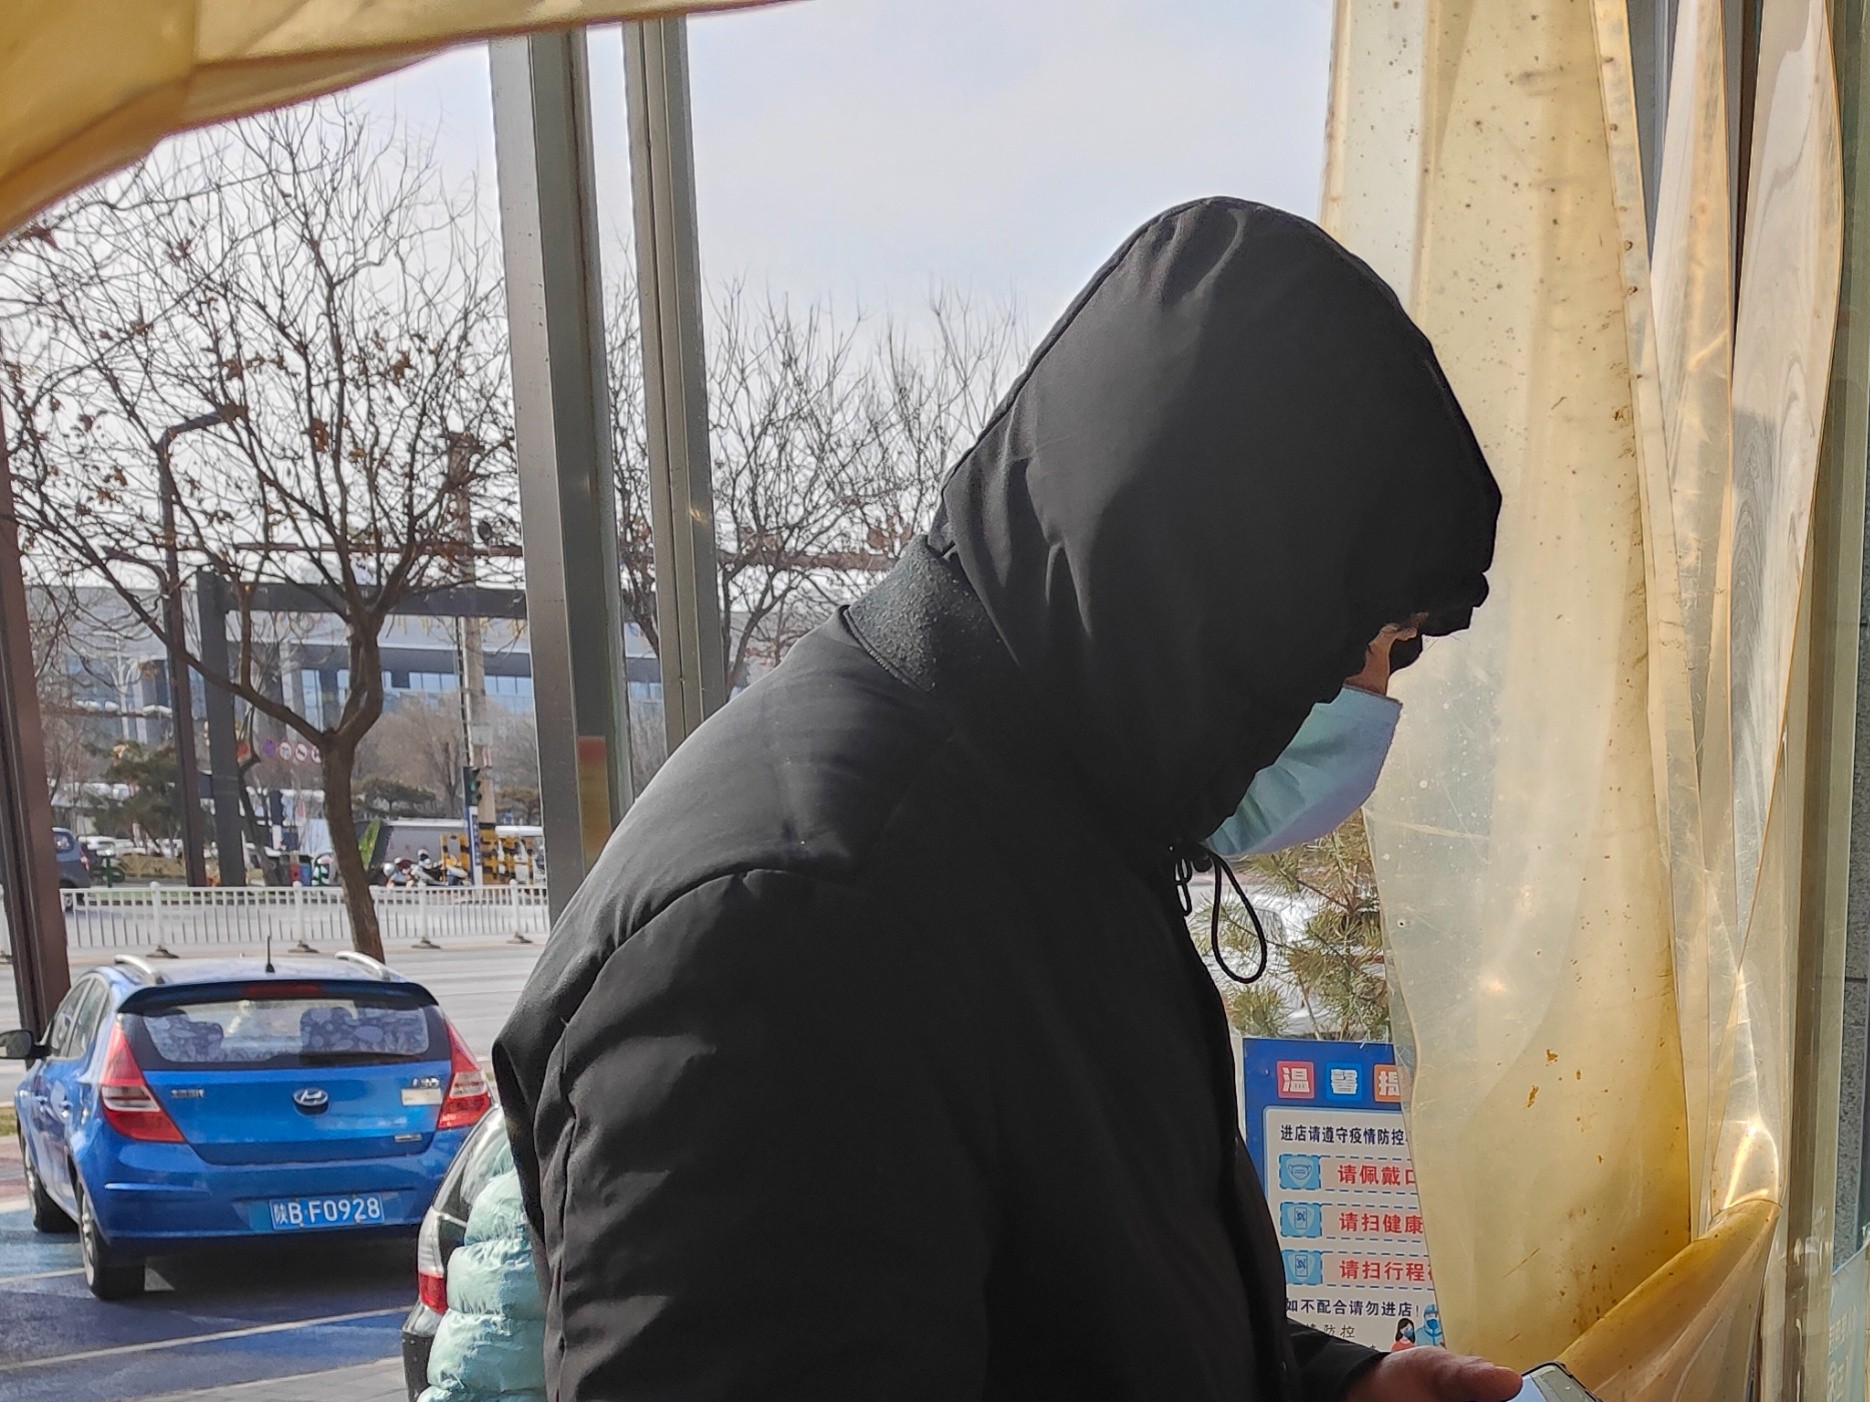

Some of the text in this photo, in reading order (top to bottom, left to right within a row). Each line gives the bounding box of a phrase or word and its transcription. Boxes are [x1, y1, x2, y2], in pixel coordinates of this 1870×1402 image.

[1280, 1124, 1409, 1146] 进店请遵守疫情防控
